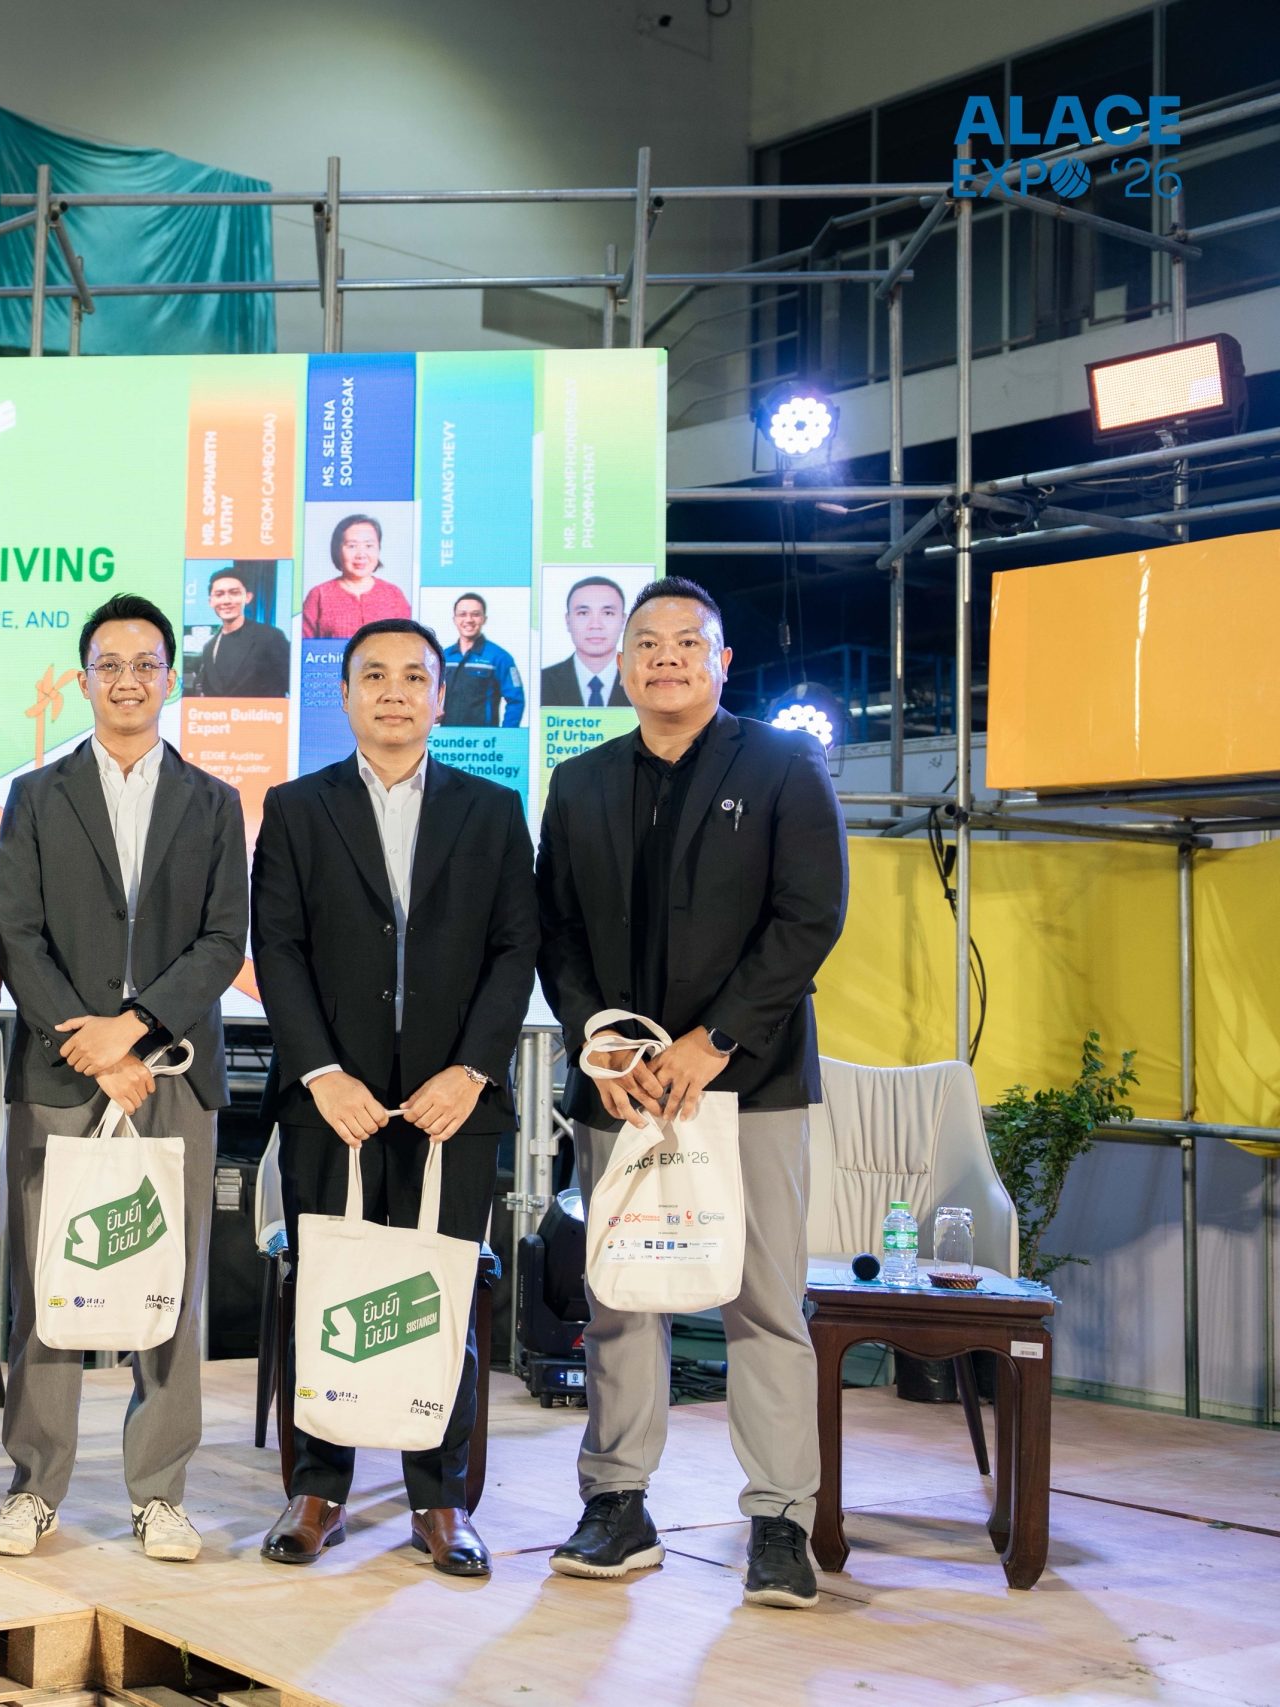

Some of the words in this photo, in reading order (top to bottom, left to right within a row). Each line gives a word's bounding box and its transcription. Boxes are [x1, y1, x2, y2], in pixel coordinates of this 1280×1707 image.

[323, 399, 336, 458] SELENA
[340, 377, 354, 486] SOURIGNOSAK
[262, 413, 277, 495] CAMBODIA)
[322, 462, 335, 487] MS.
[442, 421, 456, 535] CHUANGTHEVY
[220, 495, 234, 546] VUTHY
[441, 539, 454, 567] TEE
[25, 610, 70, 629] AND
[188, 708, 228, 721] Green
[230, 708, 283, 724] Building
[547, 716, 602, 727] Director
[187, 722, 231, 736] Expert
[547, 730, 559, 741] of
[563, 730, 604, 741] Urban
[483, 737, 496, 748] of
[429, 750, 504, 762] ensornode
[625, 1154, 654, 1175] AACE
[145, 1294, 175, 1306] ALACE
[406, 1312, 438, 1334] SUSTAINISM
[411, 1398, 444, 1413] ALACE
